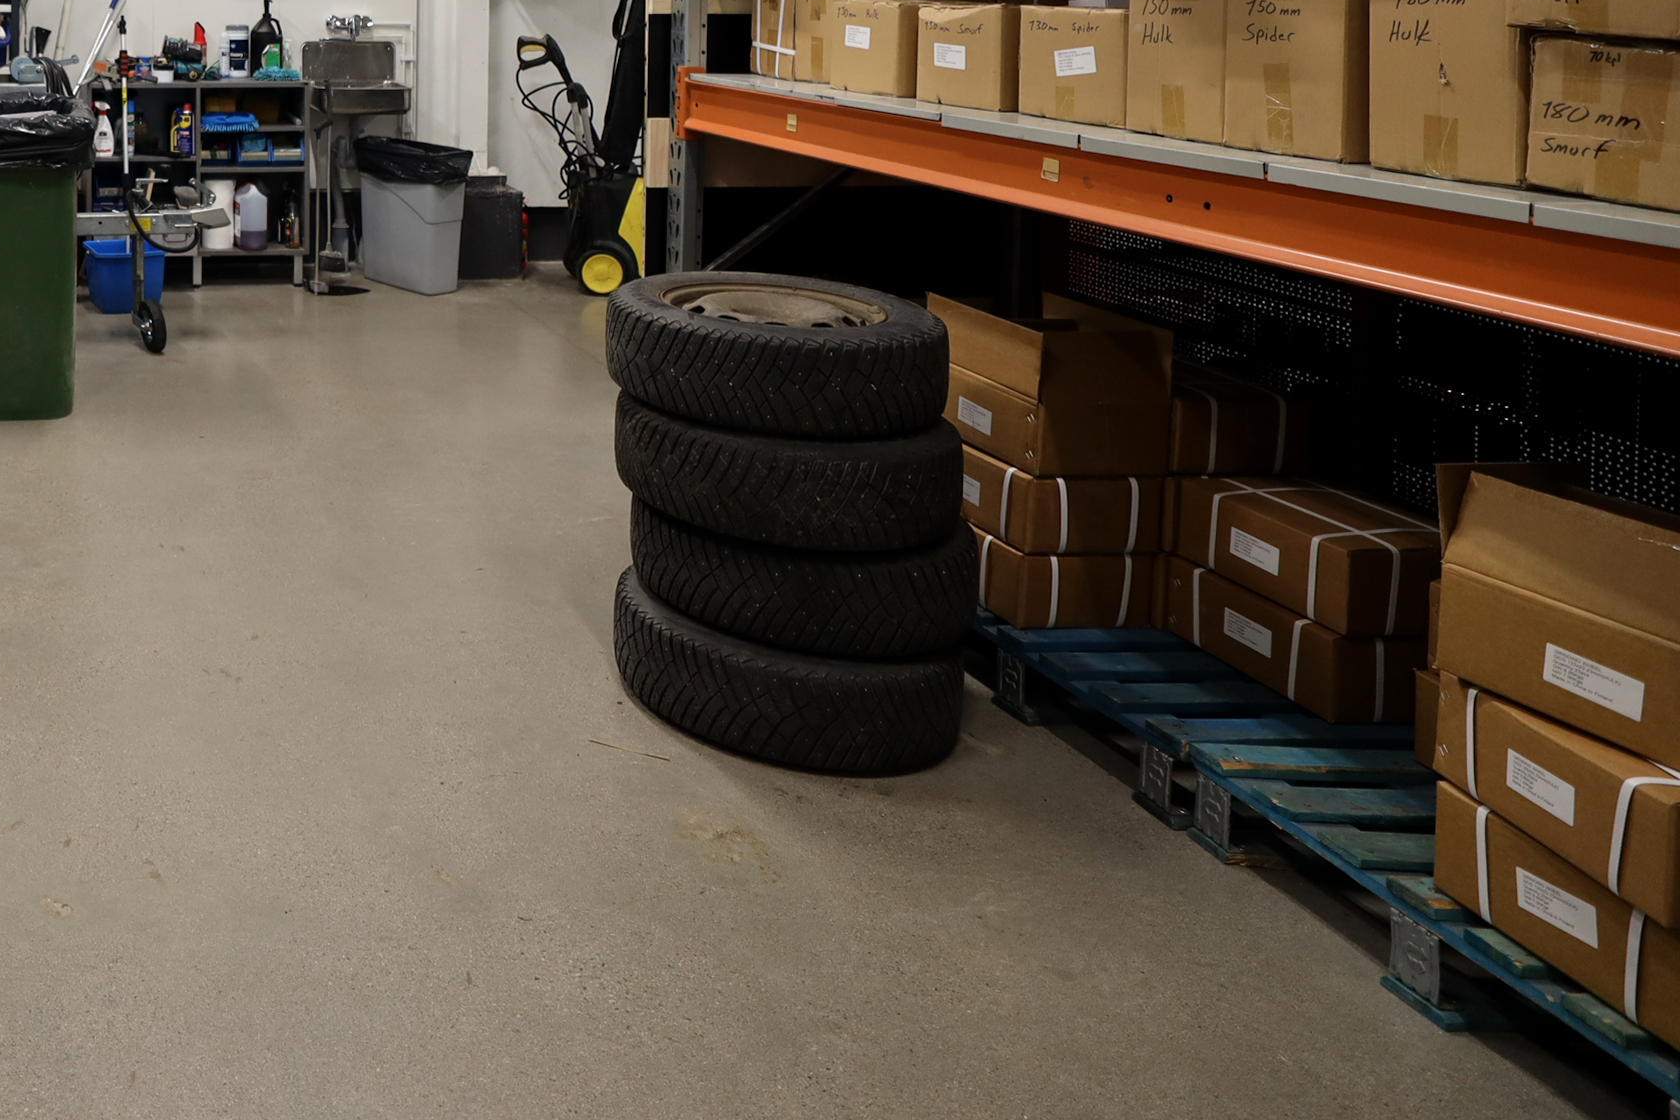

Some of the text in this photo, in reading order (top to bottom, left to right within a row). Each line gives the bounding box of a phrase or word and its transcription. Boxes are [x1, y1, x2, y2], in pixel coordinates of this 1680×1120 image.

[1072, 21, 1100, 34] Spider
[1141, 21, 1174, 46] Hulk
[1241, 22, 1296, 45] Spider
[1388, 19, 1432, 47] Hulk
[1540, 137, 1617, 160] Smurf
